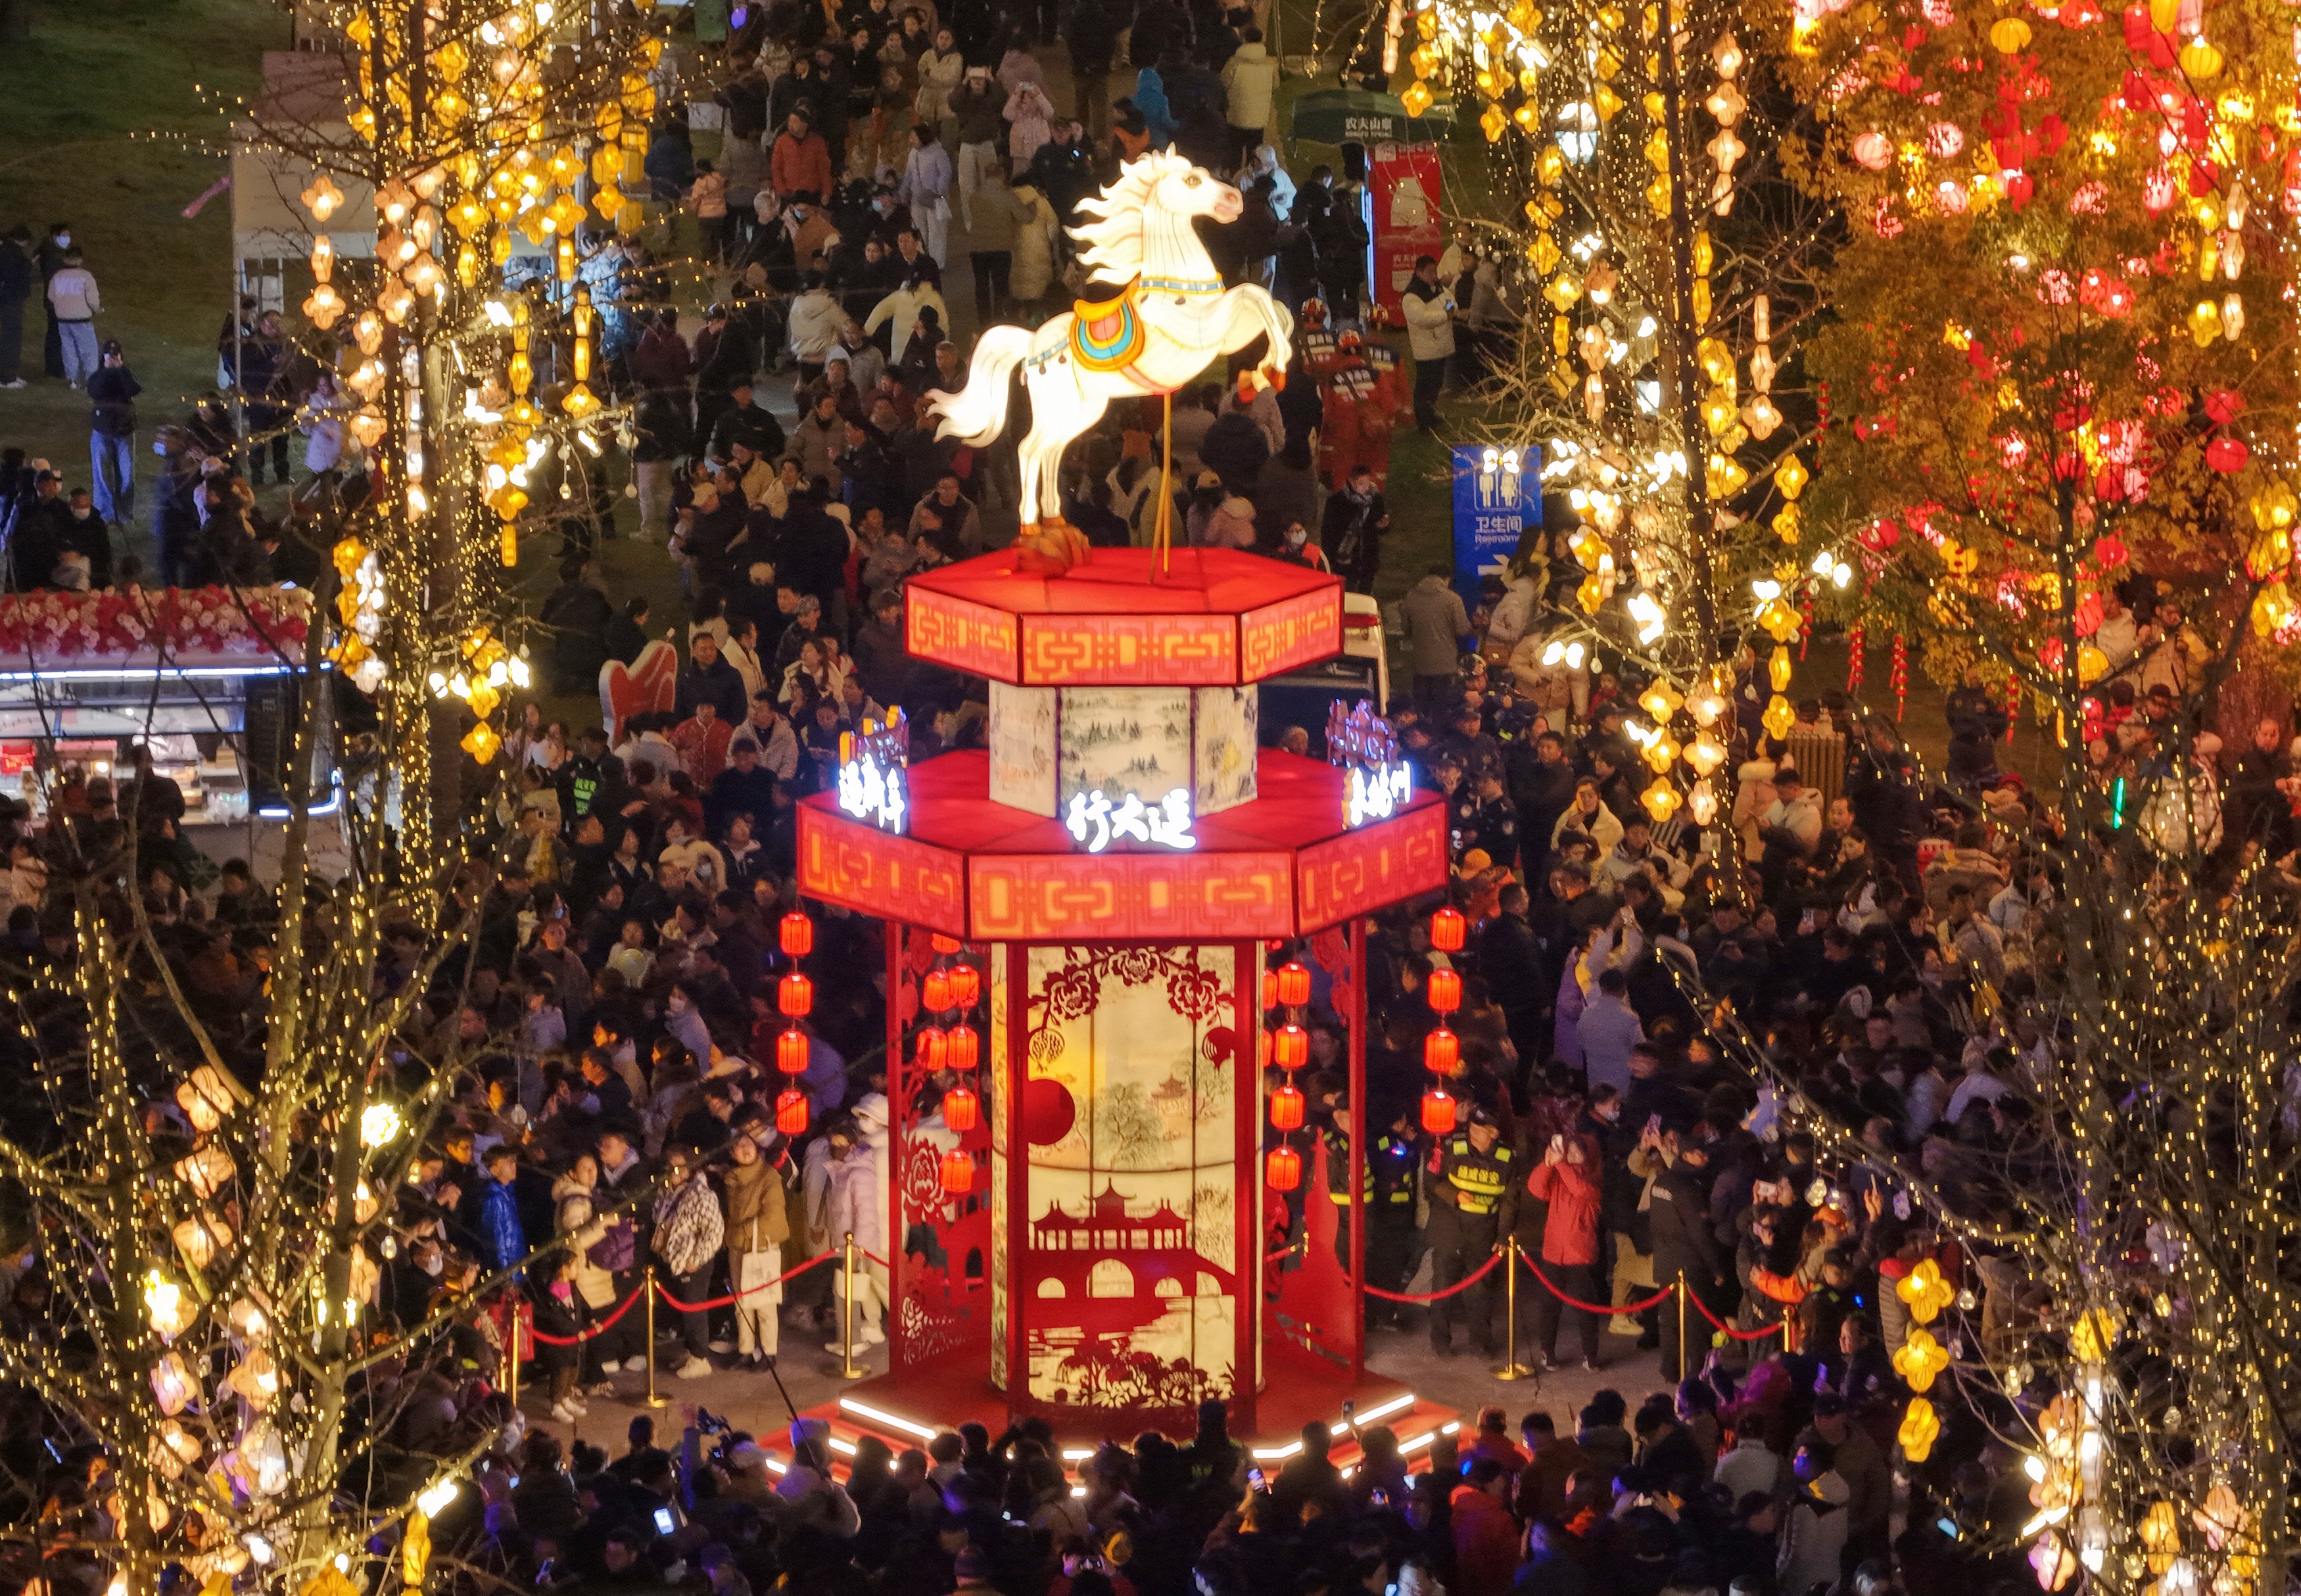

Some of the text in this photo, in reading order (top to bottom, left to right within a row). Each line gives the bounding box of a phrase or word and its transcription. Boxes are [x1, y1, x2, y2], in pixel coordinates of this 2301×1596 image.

[1345, 117, 1392, 130] 农夫山泉
[1475, 515, 1523, 533] 卫生间
